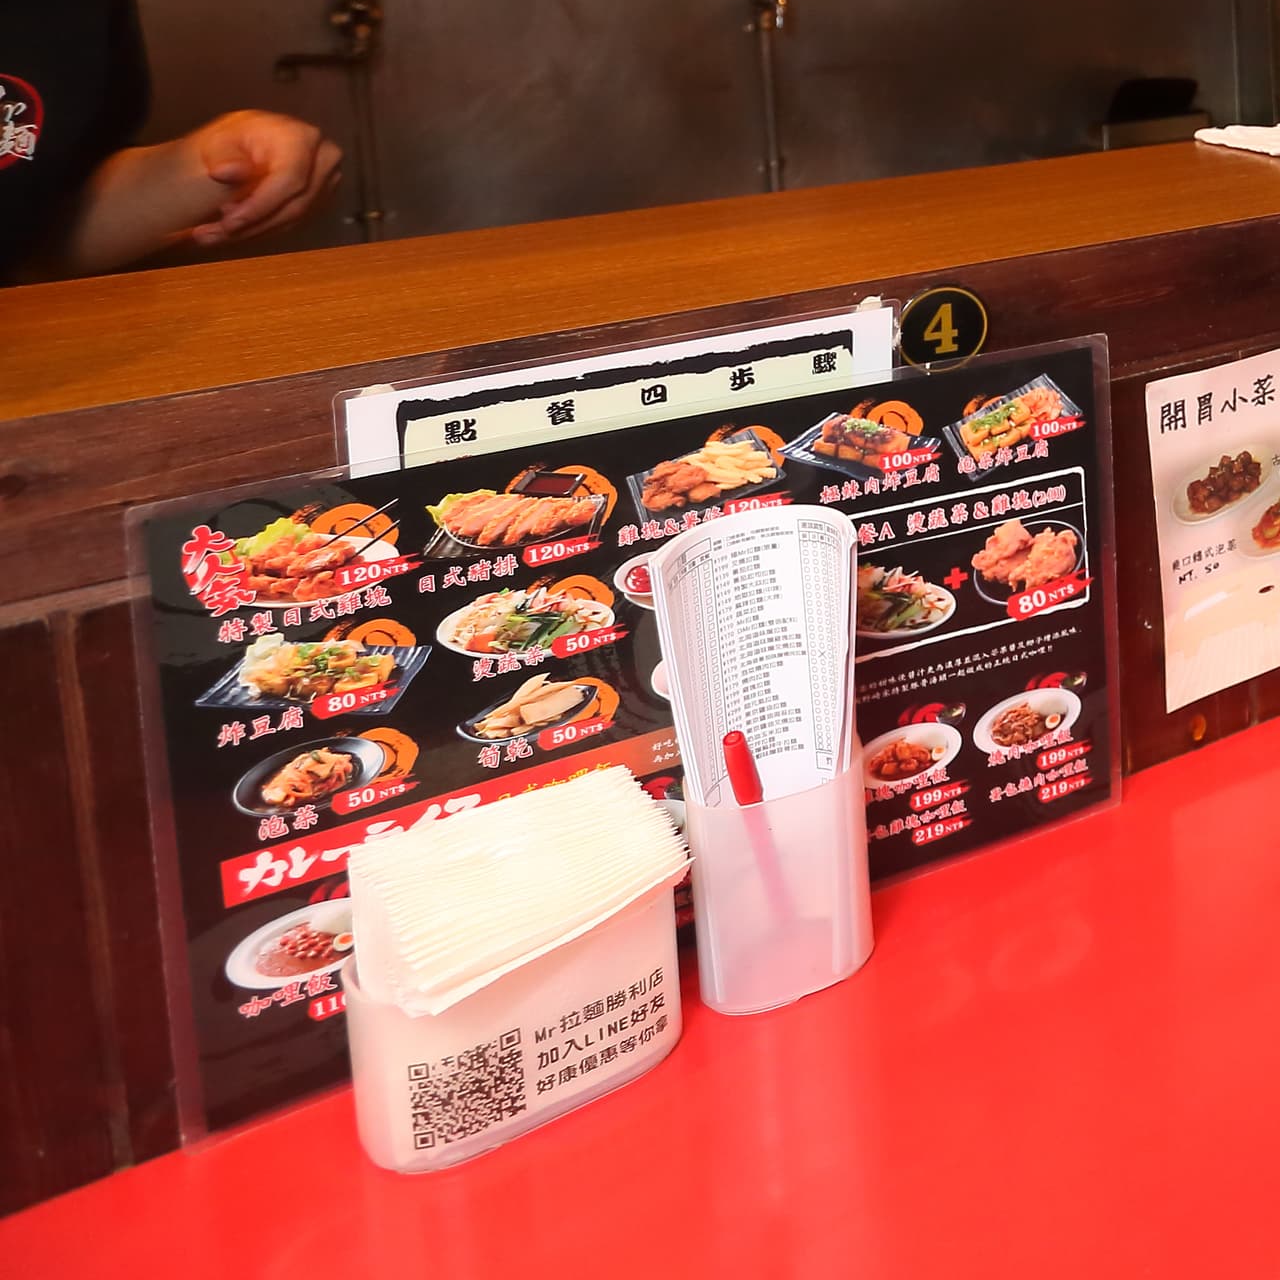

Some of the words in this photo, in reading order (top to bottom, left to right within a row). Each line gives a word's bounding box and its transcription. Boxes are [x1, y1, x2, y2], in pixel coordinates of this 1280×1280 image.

[923, 303, 958, 354] 4
[957, 439, 1050, 474] 泡菜炸豆腐
[418, 554, 519, 593] 日式豬排
[218, 586, 392, 643] 特製日式雞塊
[472, 646, 545, 682] 燙蔬菜
[217, 706, 304, 749] 炸豆腐
[477, 738, 534, 769] 筍乾
[258, 804, 319, 841] 泡菜
[239, 971, 337, 1019] 咖哩飯
[536, 1015, 668, 1095] 好康優惠等你拿
